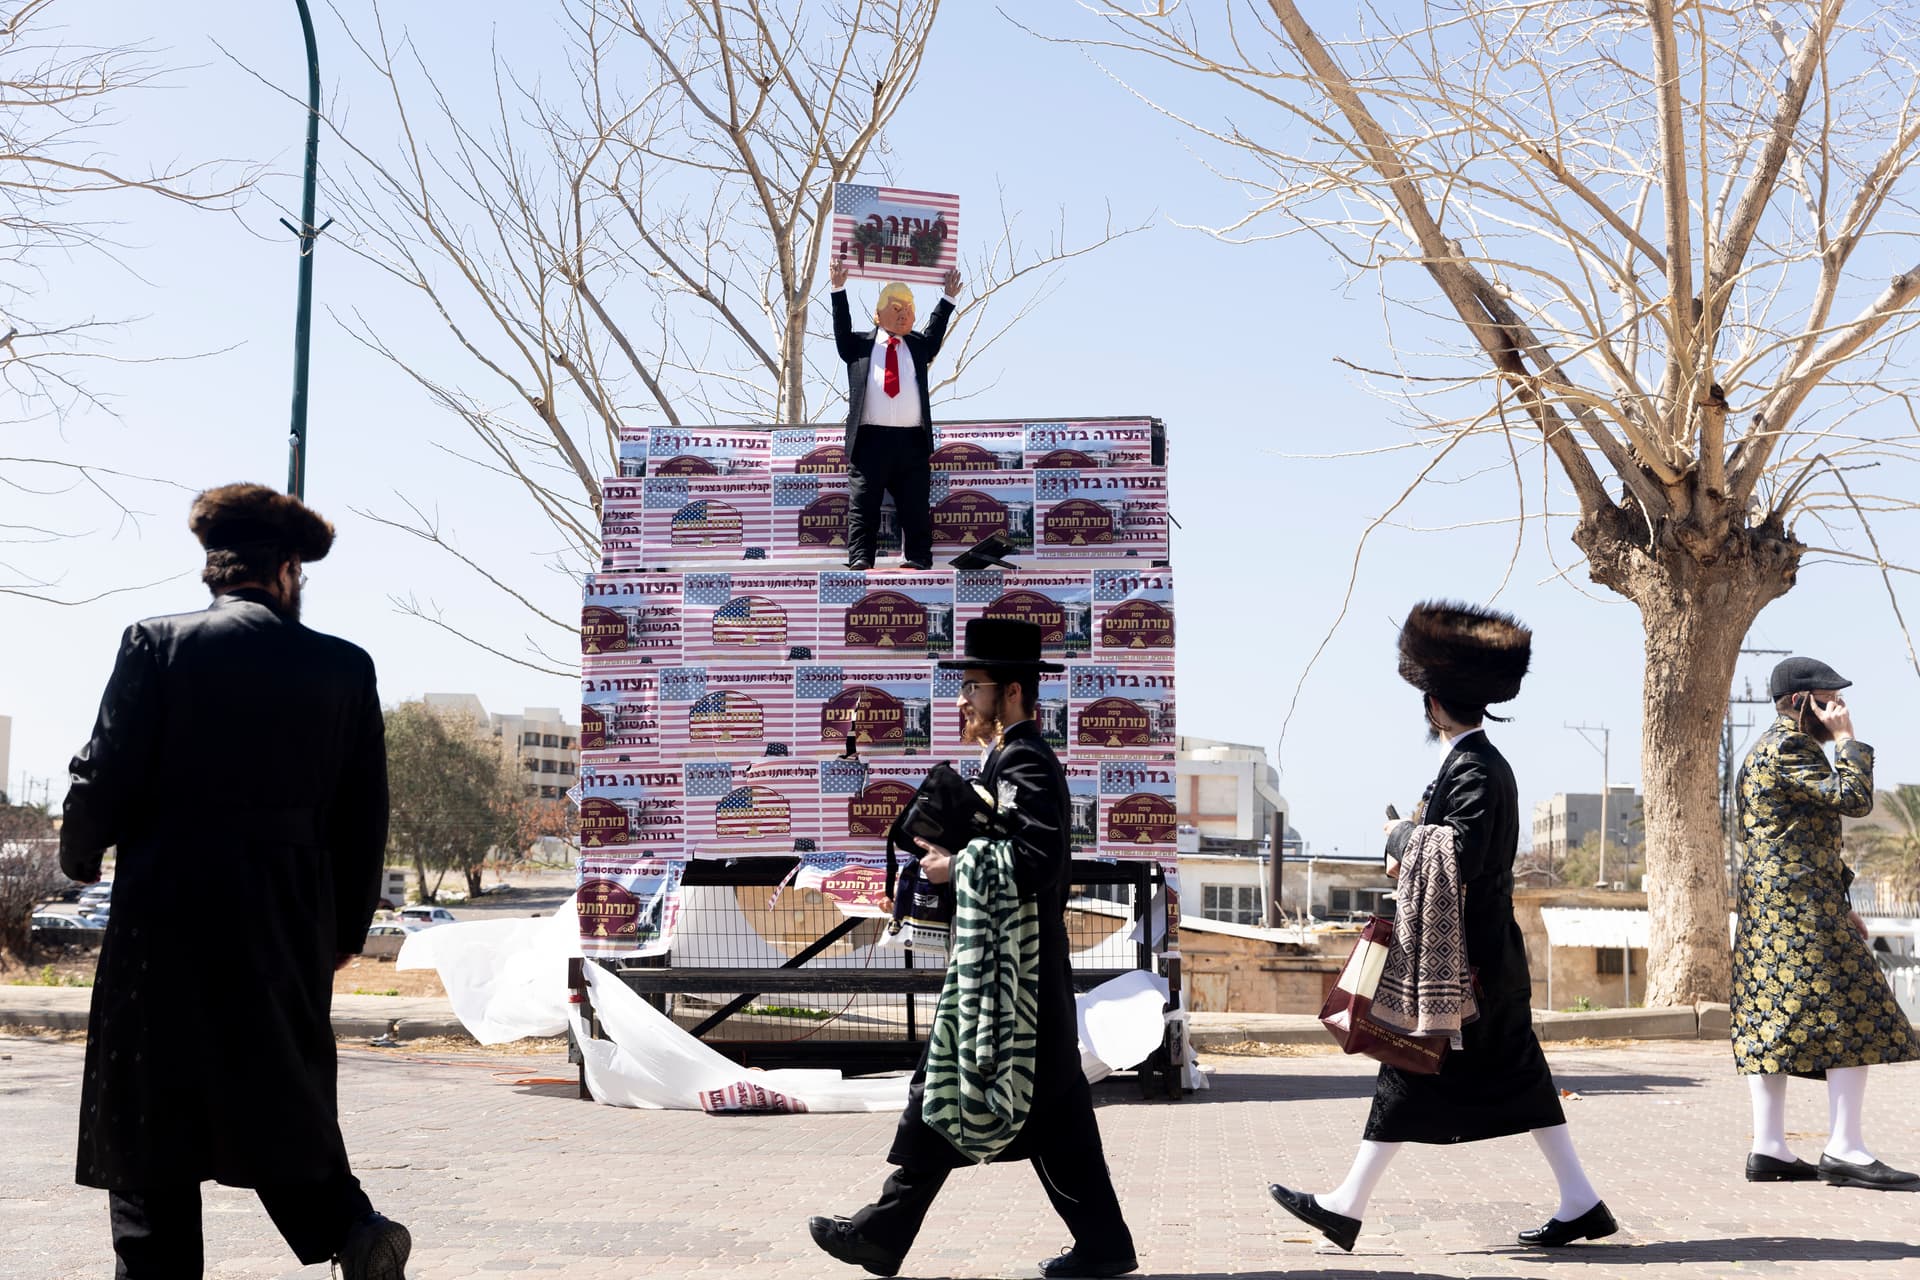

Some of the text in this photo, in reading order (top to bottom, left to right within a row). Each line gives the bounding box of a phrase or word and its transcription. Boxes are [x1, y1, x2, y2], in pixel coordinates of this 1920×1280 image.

[1031, 430, 1146, 444] העזרה בדרך?!
[656, 436, 767, 450] העזרה בדרך?!
[1042, 477, 1161, 494] העזרה בדרך?!
[803, 516, 838, 526] חתנים
[934, 512, 1005, 523] עזרת חתנים
[1048, 517, 1109, 527] עזרת חתנים
[623, 583, 677, 594] העזרה
[1100, 577, 1163, 594] בדרך?!
[638, 606, 676, 617] אצלינו
[850, 614, 923, 625] עזרת חתנים
[1029, 613, 1060, 625] עזרת
[1106, 619, 1169, 629] עזרת חתנים
[598, 624, 624, 634] עזרת
[600, 678, 653, 691] העזרה
[1077, 675, 1139, 692] בדרך?!
[869, 709, 900, 720] עזרת
[1082, 717, 1116, 727] חתנים
[1119, 717, 1146, 728] עזרת
[623, 773, 677, 786] העזרה
[1106, 770, 1170, 787] בדרך?!
[638, 797, 679, 809] אצלינו
[853, 804, 891, 815] חתנים
[598, 817, 624, 827] עזרת
[1112, 813, 1176, 824] עזרת חתנים
[826, 881, 865, 889] חתנים
[605, 903, 635, 915] עזרת
